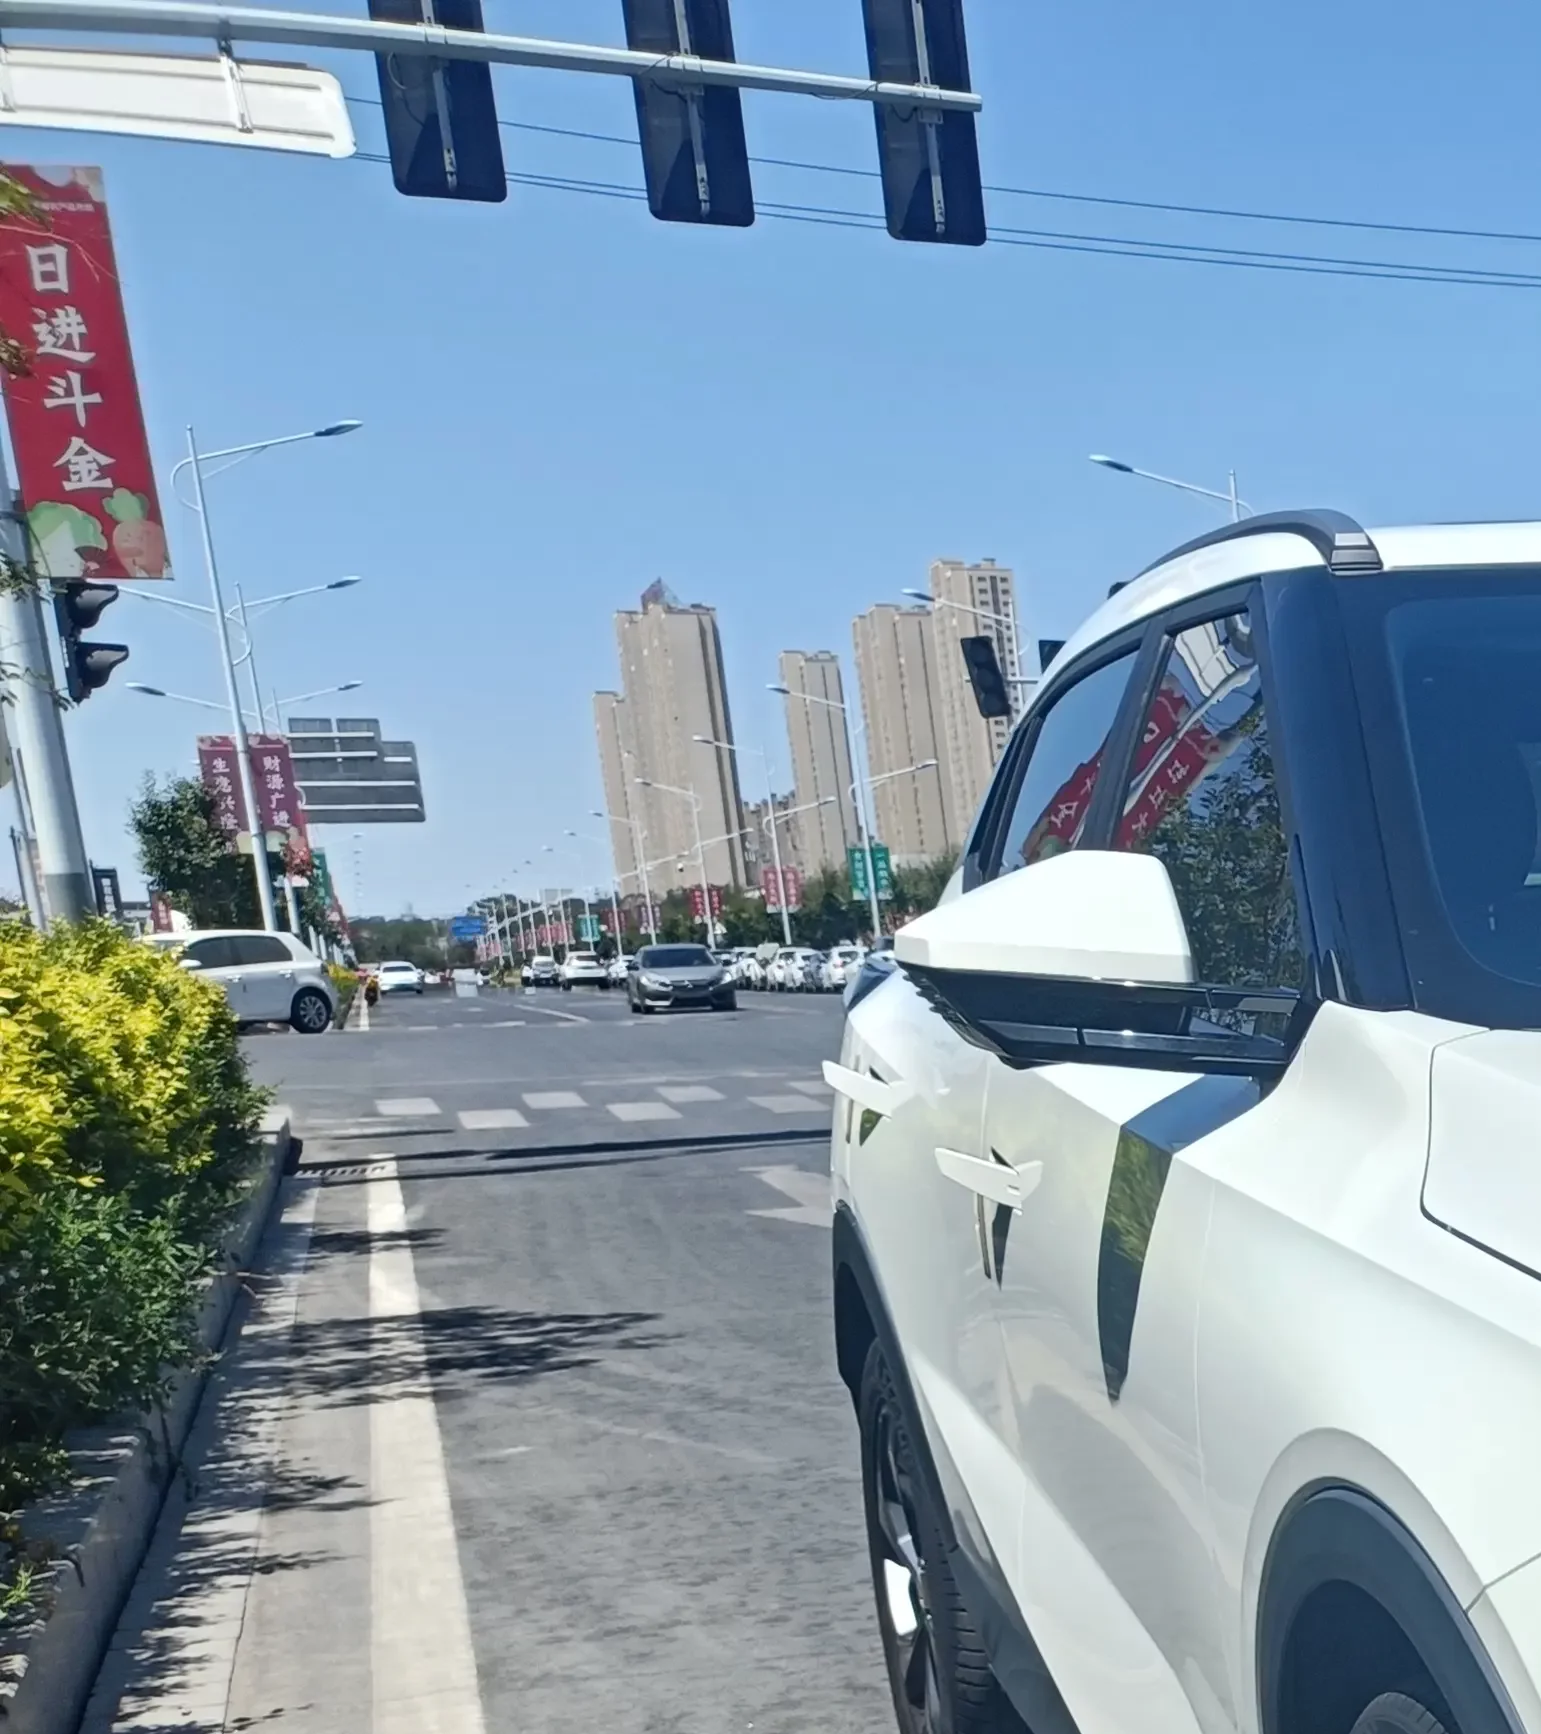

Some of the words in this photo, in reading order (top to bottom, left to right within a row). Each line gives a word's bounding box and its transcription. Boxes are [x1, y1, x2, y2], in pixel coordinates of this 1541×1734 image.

[25, 243, 116, 491] 日进斗金
[262, 756, 290, 828] 财源广进
